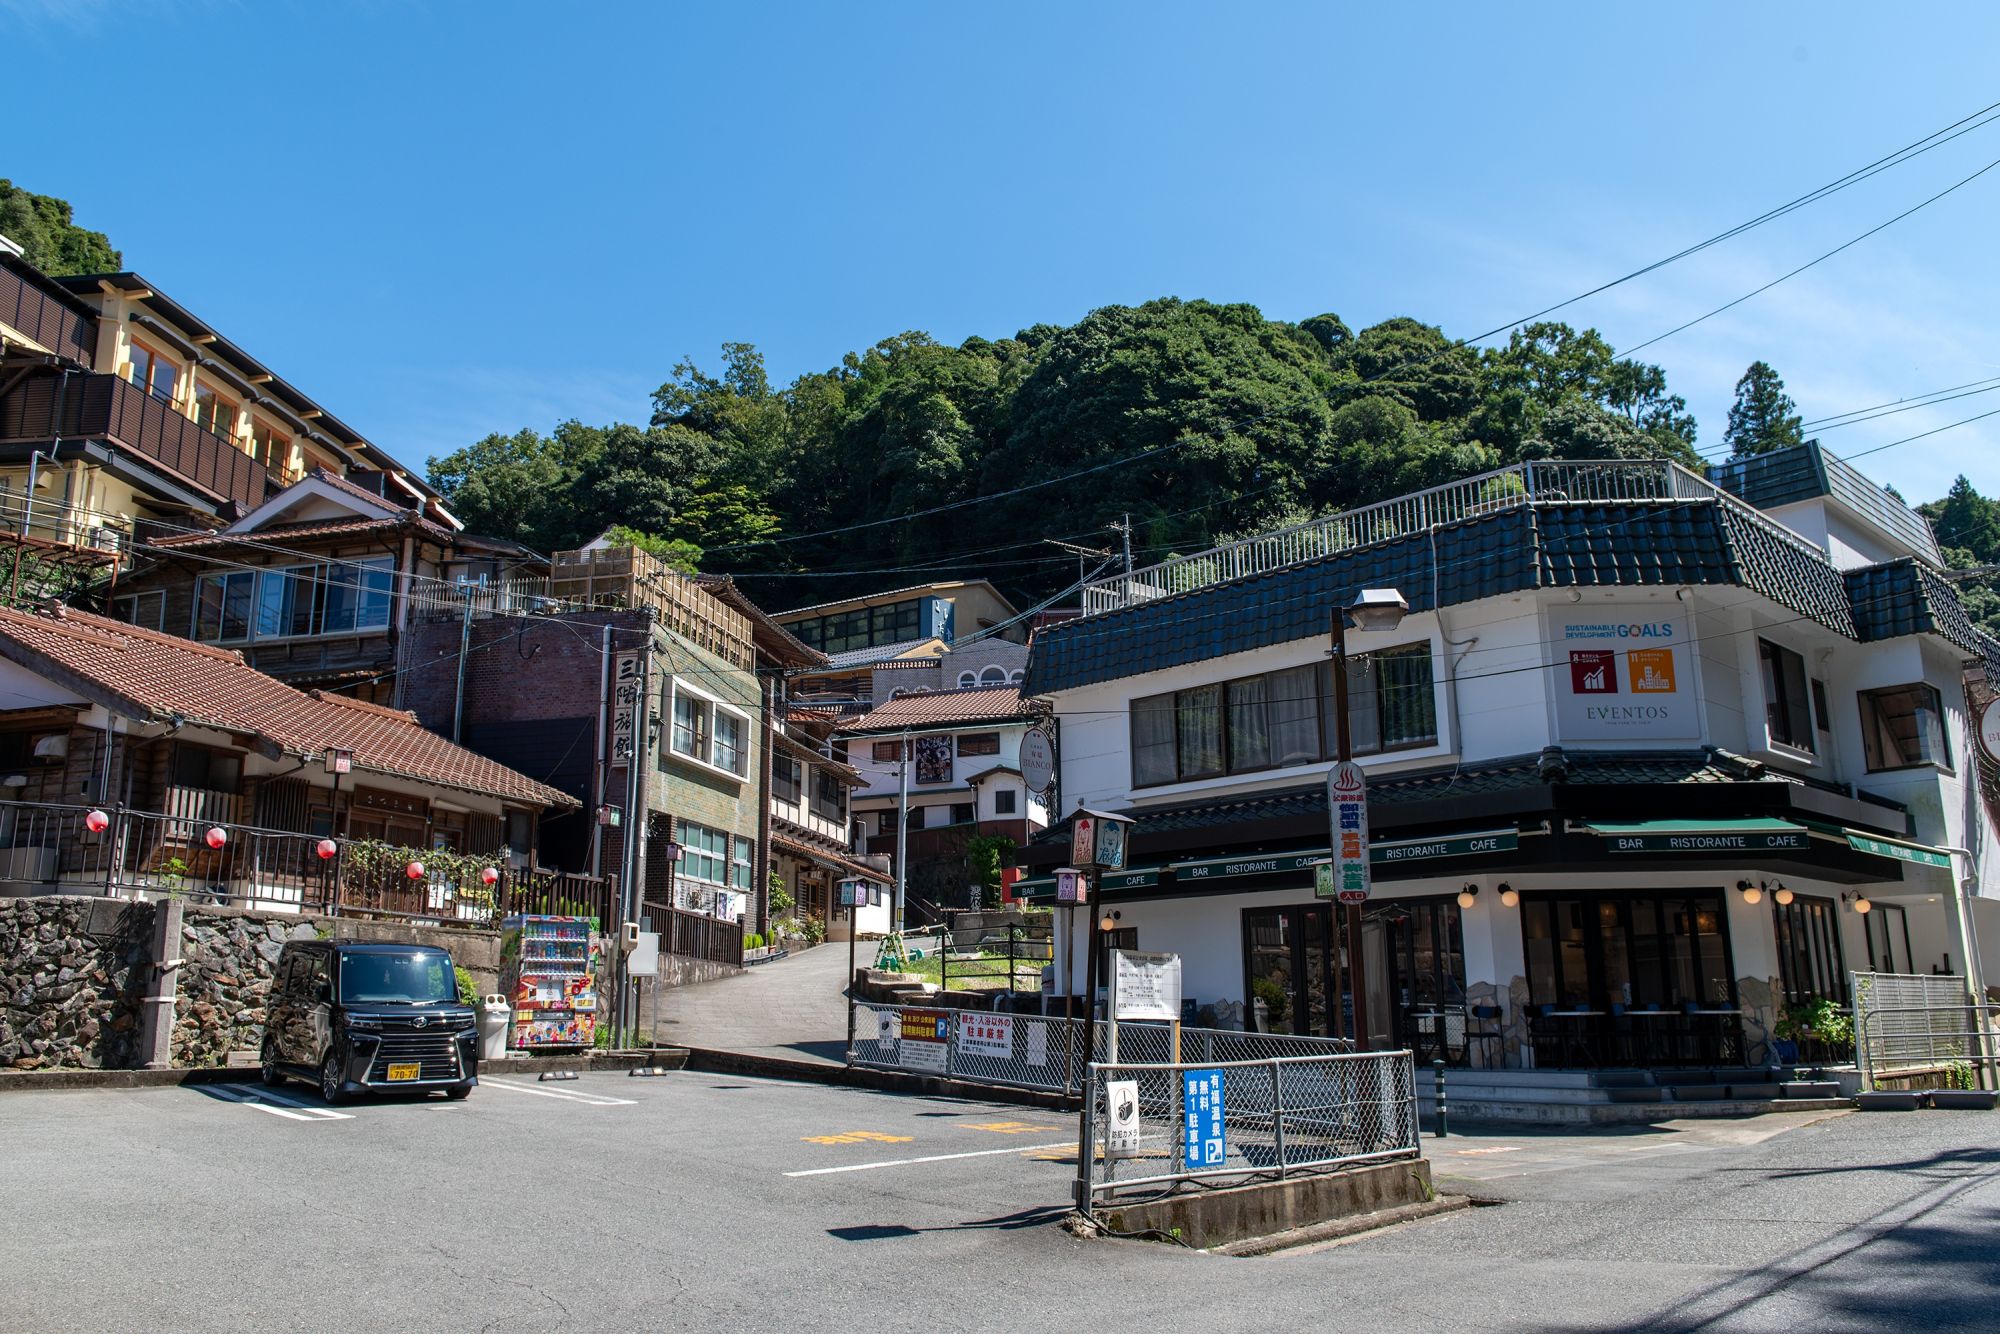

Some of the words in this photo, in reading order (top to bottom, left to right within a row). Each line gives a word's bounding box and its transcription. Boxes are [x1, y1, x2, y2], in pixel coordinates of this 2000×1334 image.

[1617, 624, 1672, 637] GOALS
[1587, 705, 1668, 720] EVENTOS
[1023, 759, 1051, 770] BIANCO
[1386, 844, 1447, 859] RISTORANTE
[1470, 838, 1497, 851] CAFE
[1619, 838, 1643, 849] BAR
[1670, 836, 1746, 848] RISTORANTE
[1767, 835, 1798, 847] CAFE
[1192, 867, 1208, 877] BAR
[1226, 861, 1277, 874] RISTORANTE
[1022, 887, 1035, 895] BAR
[1126, 876, 1145, 885] CAFE
[1343, 892, 1364, 900] 入口
[938, 1021, 945, 1036] P
[395, 1070, 418, 1079] 70-70
[1199, 1080, 1209, 1111] 無料
[1210, 1074, 1221, 1136] 有福温泉
[1188, 1080, 1198, 1160] 第1駐車場
[1112, 1129, 1138, 1139] 防犯カメラ
[1111, 1138, 1138, 1148] 作動中
[1207, 1143, 1216, 1161] P
